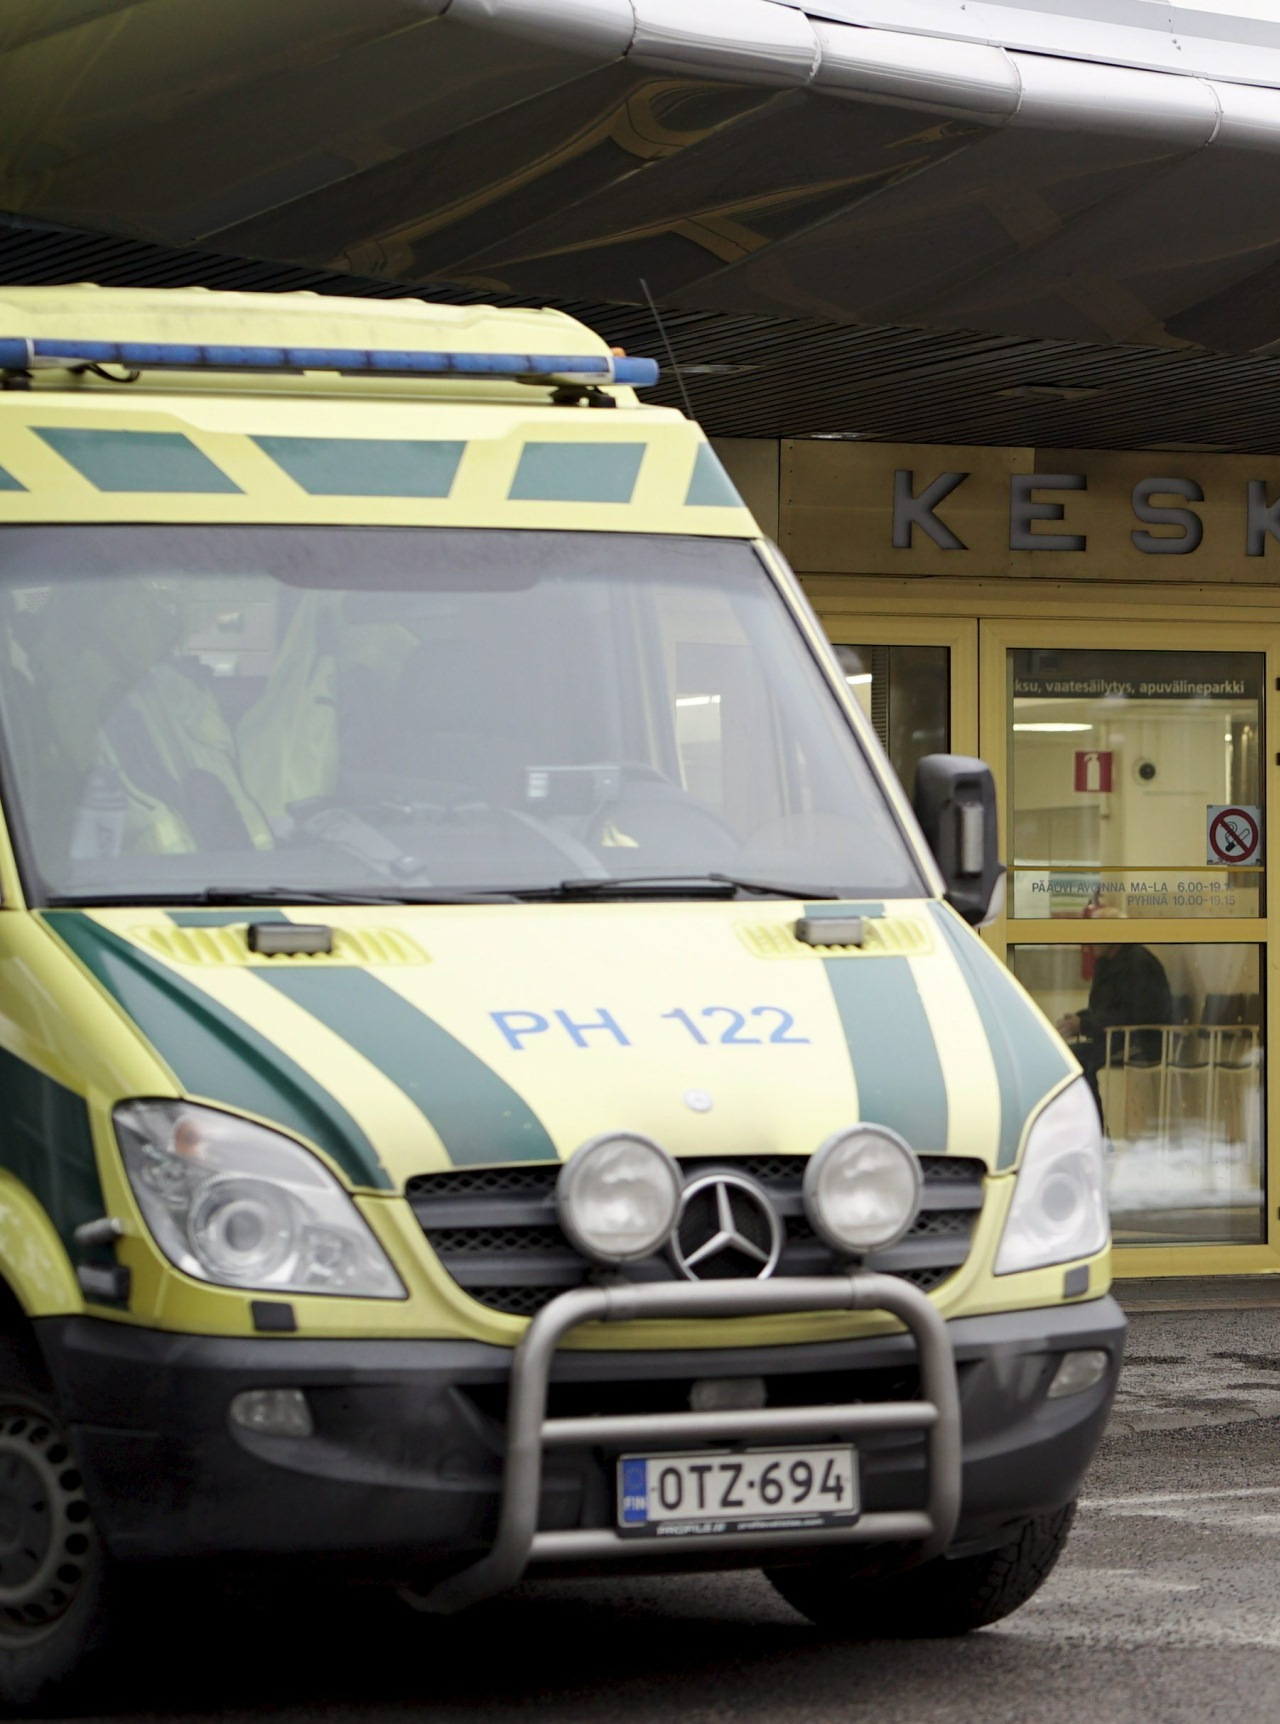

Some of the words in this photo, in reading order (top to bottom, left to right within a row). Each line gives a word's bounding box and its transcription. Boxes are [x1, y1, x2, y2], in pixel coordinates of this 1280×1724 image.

[1139, 680, 1245, 695] apuvälineparkki
[1130, 882, 1169, 893] MA-LA
[487, 1008, 633, 1050] PH
[660, 1006, 812, 1045] 122
[658, 1458, 845, 1511] OTZ-694
